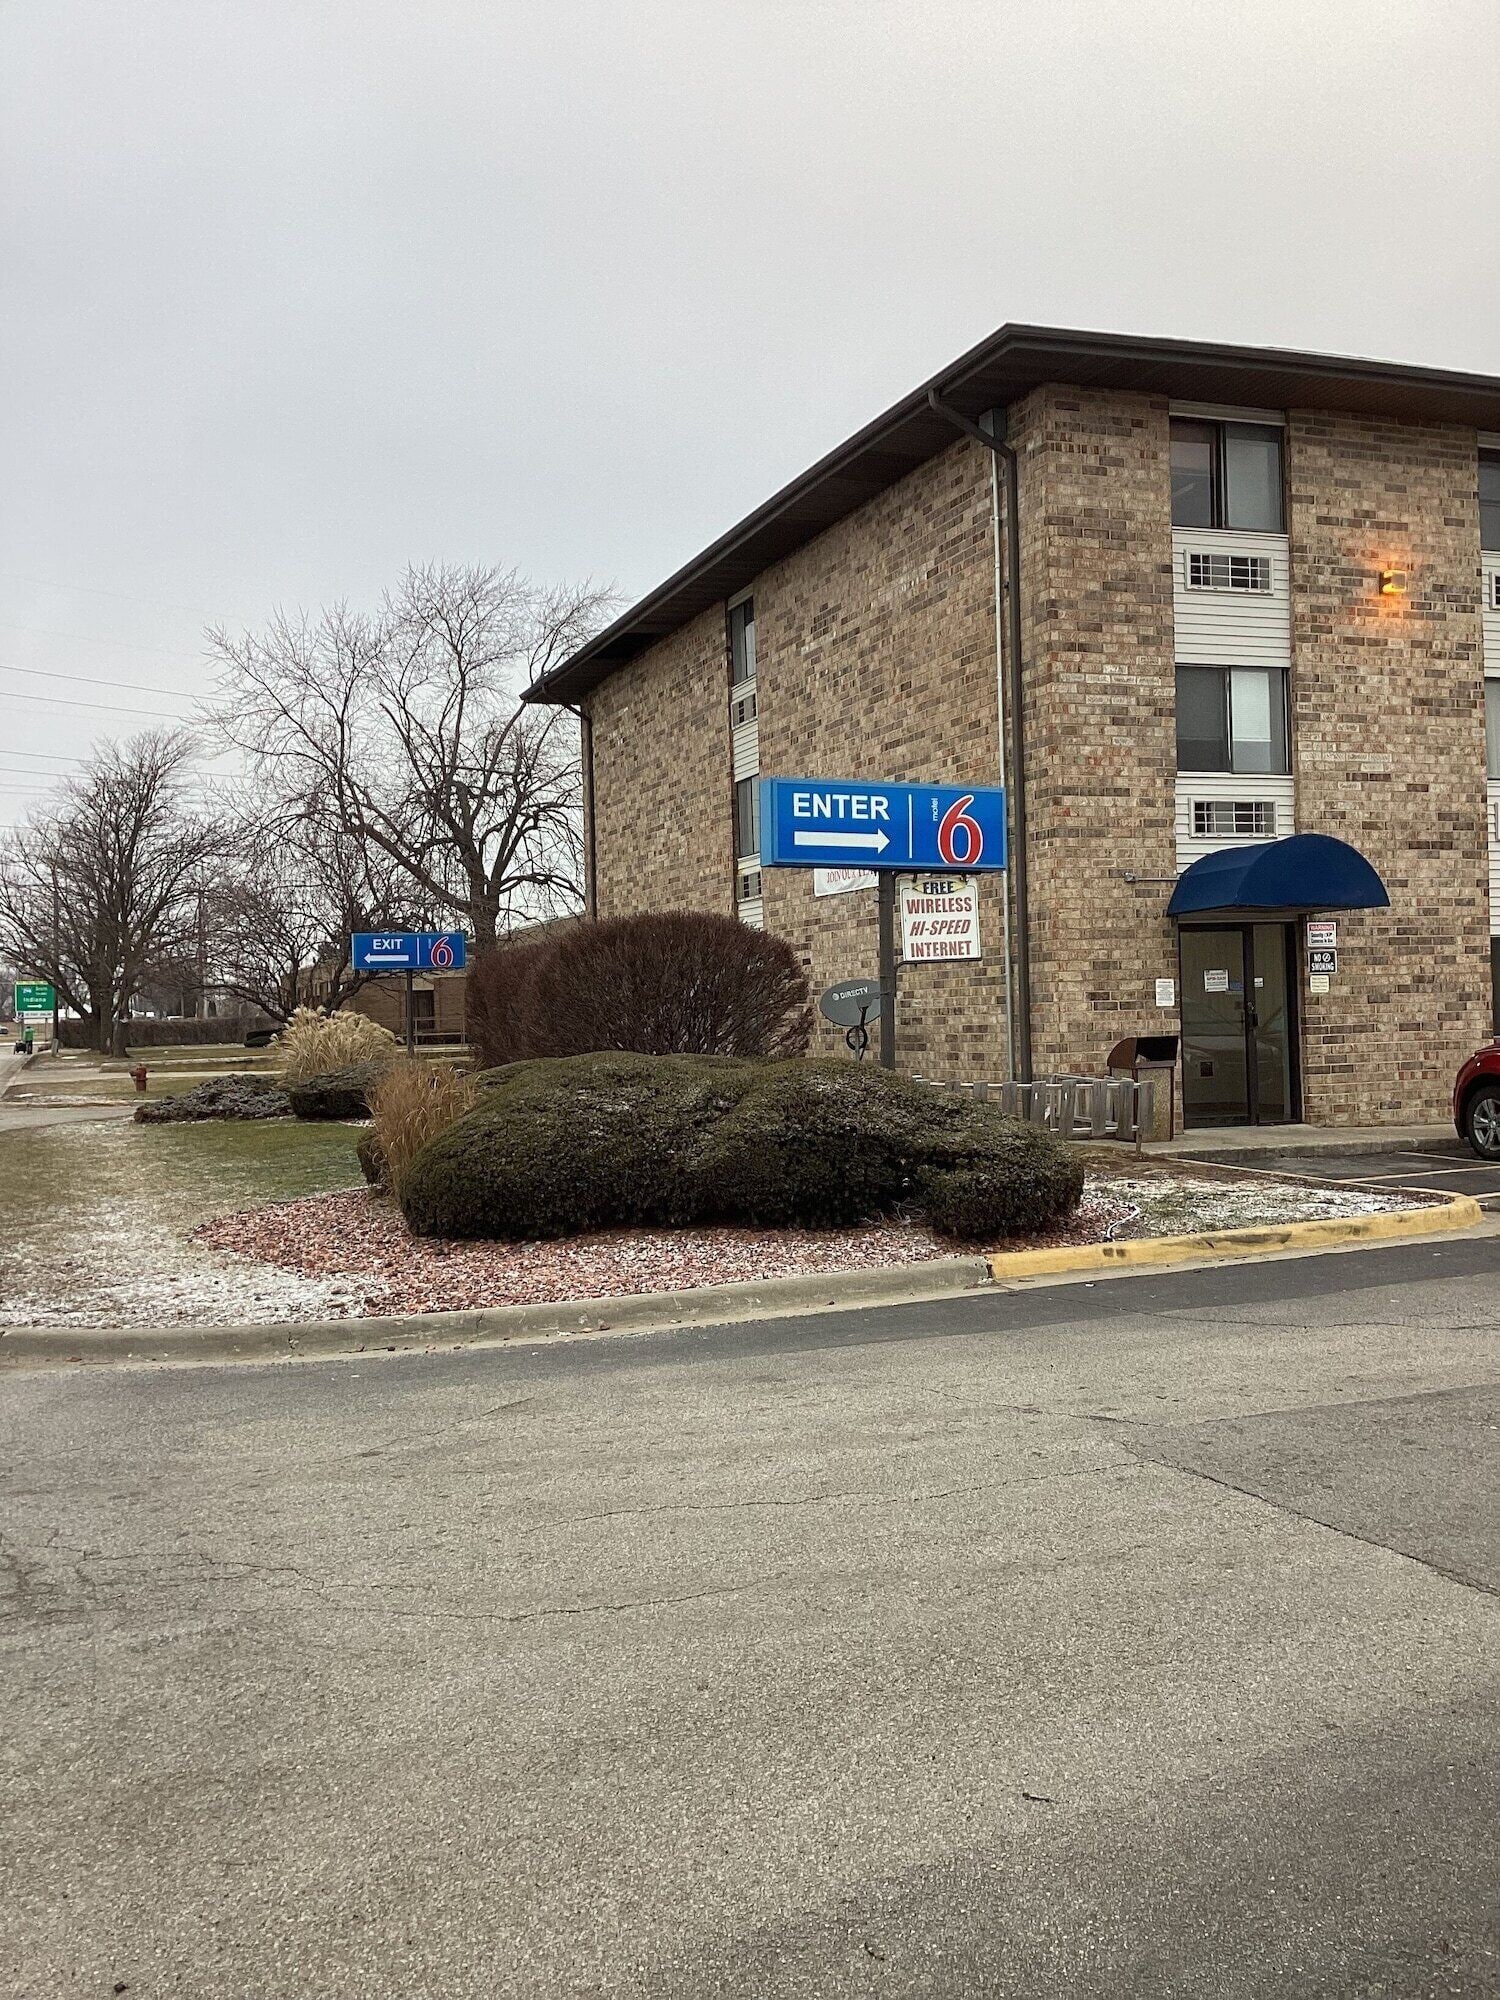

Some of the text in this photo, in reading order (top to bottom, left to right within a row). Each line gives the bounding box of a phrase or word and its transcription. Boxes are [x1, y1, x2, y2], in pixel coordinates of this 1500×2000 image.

[793, 792, 890, 820] ENTER
[931, 798, 939, 821] motel
[937, 794, 984, 865] 6
[923, 881, 955, 894] FREE
[906, 896, 973, 914] WIRELESS
[909, 919, 972, 936] HI-SPEED
[372, 938, 403, 950] EXIT
[431, 936, 454, 968] 6
[910, 940, 972, 958] INTERNET
[1313, 953, 1321, 962] NO
[1311, 962, 1334, 971] SMOKING
[839, 986, 868, 999] DIRECTV
